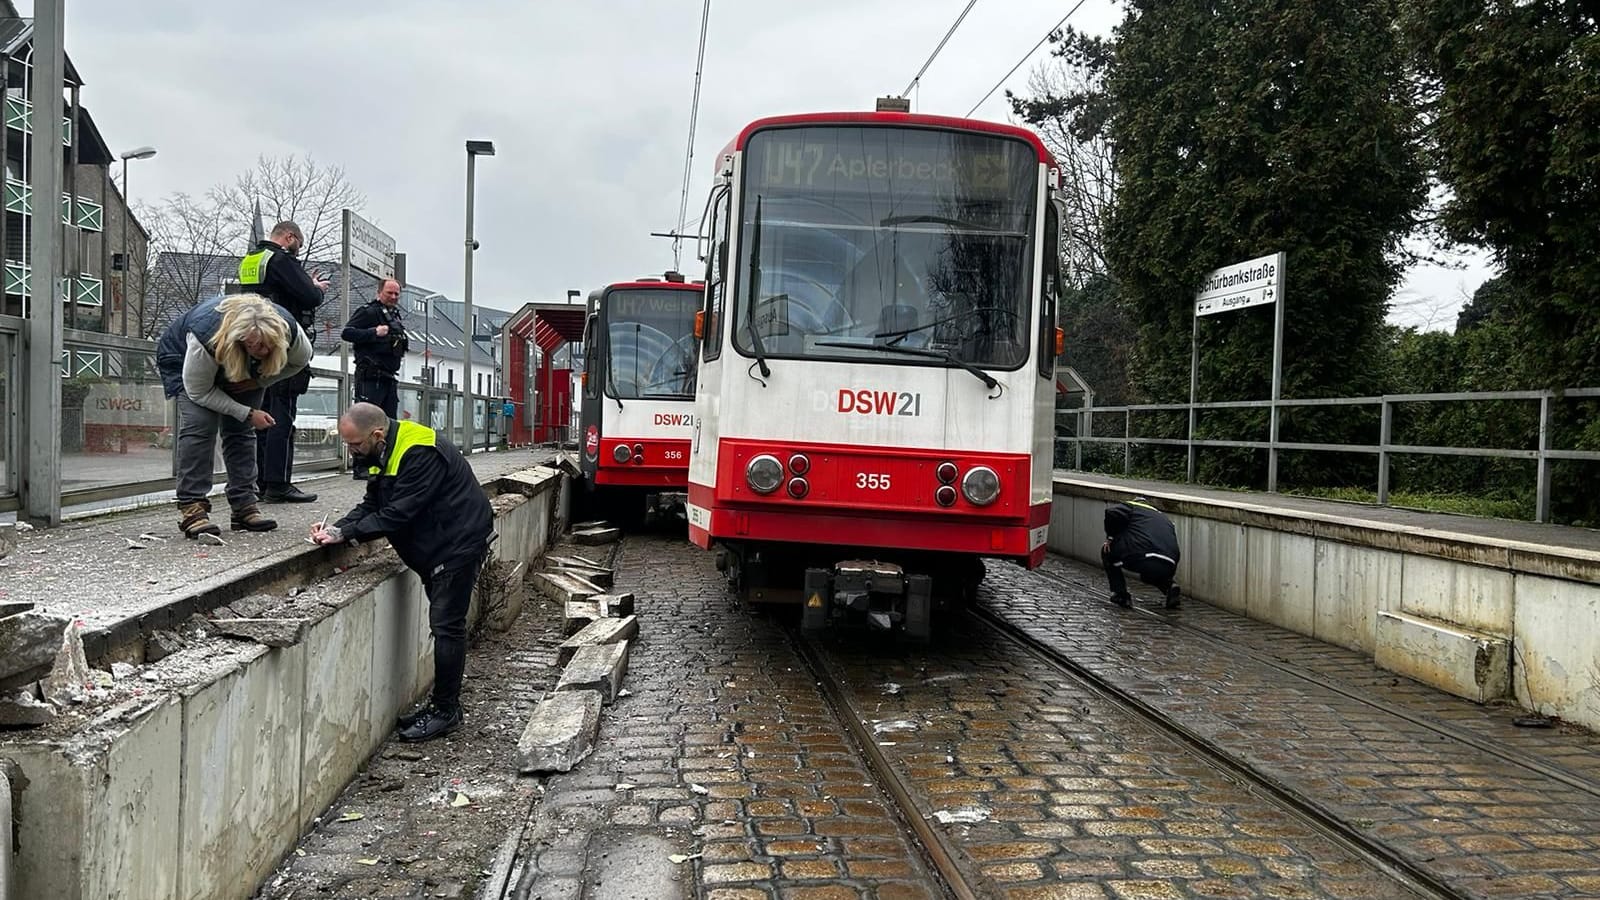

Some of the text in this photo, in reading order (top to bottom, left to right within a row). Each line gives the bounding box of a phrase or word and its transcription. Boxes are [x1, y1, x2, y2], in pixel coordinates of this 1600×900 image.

[838, 389, 921, 417] DSW21
[654, 413, 694, 426] DSW21
[664, 450, 682, 460] 356
[856, 472, 891, 490] 355
